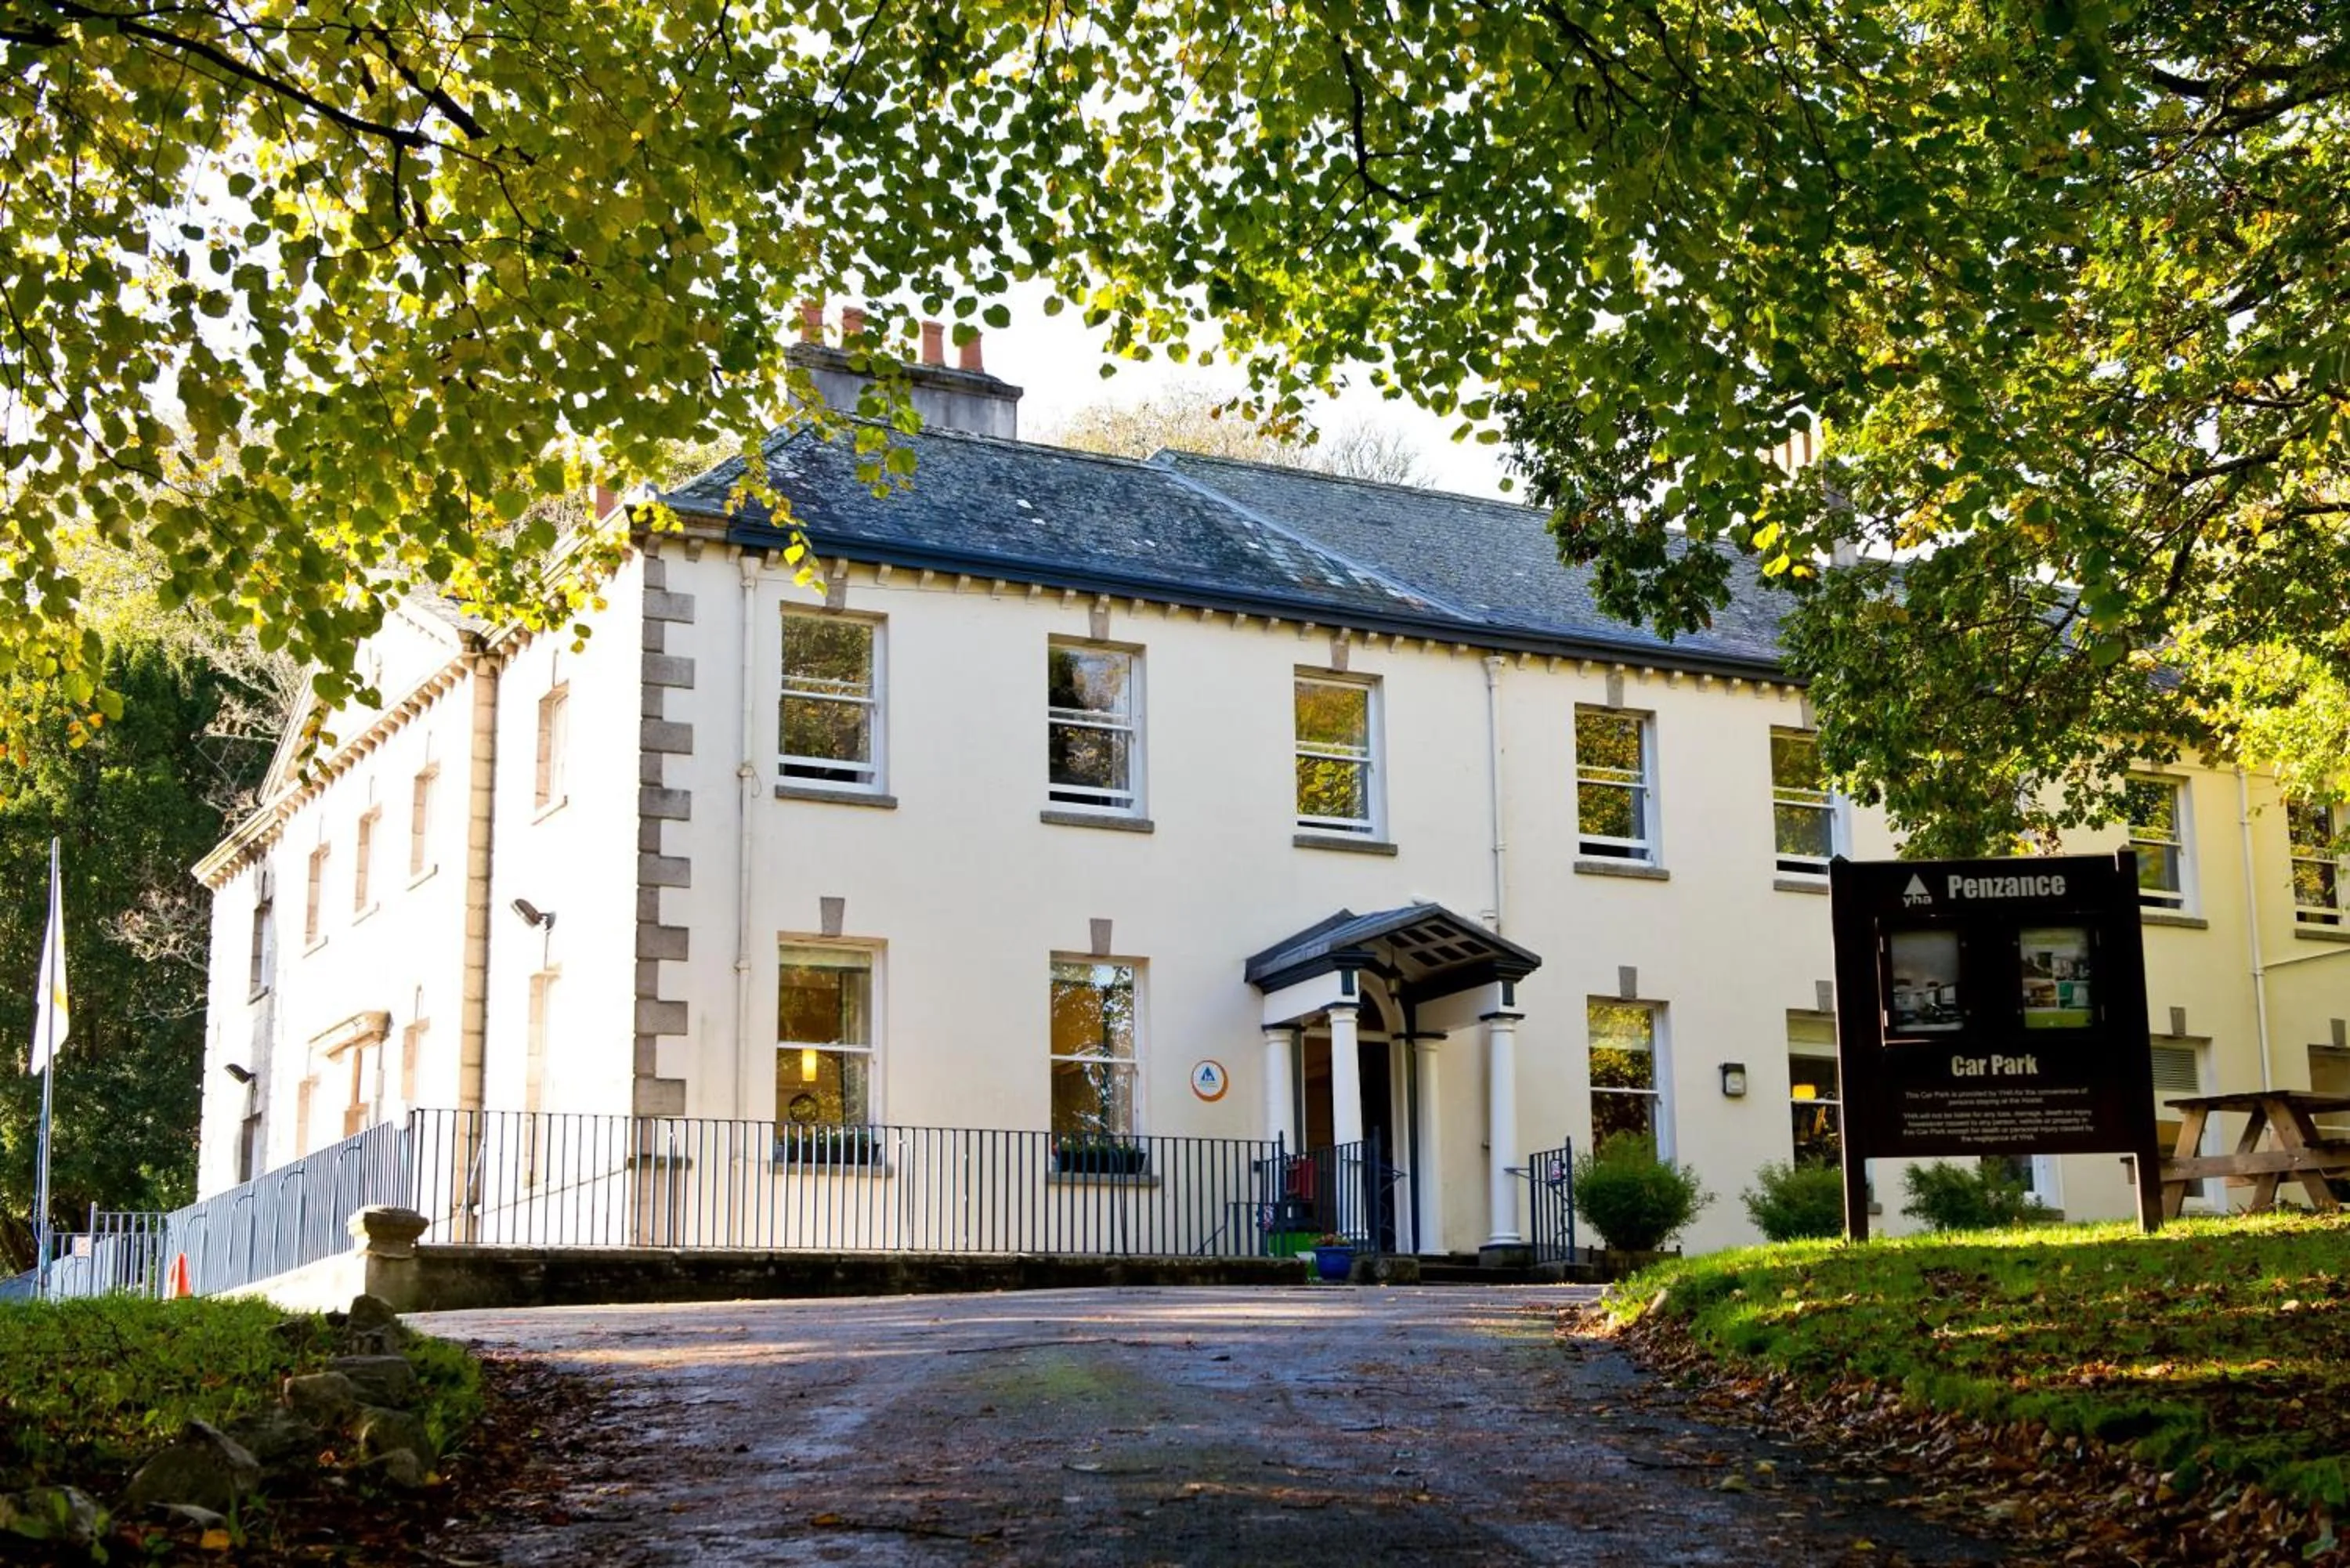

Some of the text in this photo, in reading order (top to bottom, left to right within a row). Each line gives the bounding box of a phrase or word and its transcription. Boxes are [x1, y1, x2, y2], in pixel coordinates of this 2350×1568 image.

[1948, 876, 2065, 898] Penzance
[1903, 894, 1932, 908] yha
[1952, 1054, 2038, 1076] Car Park
